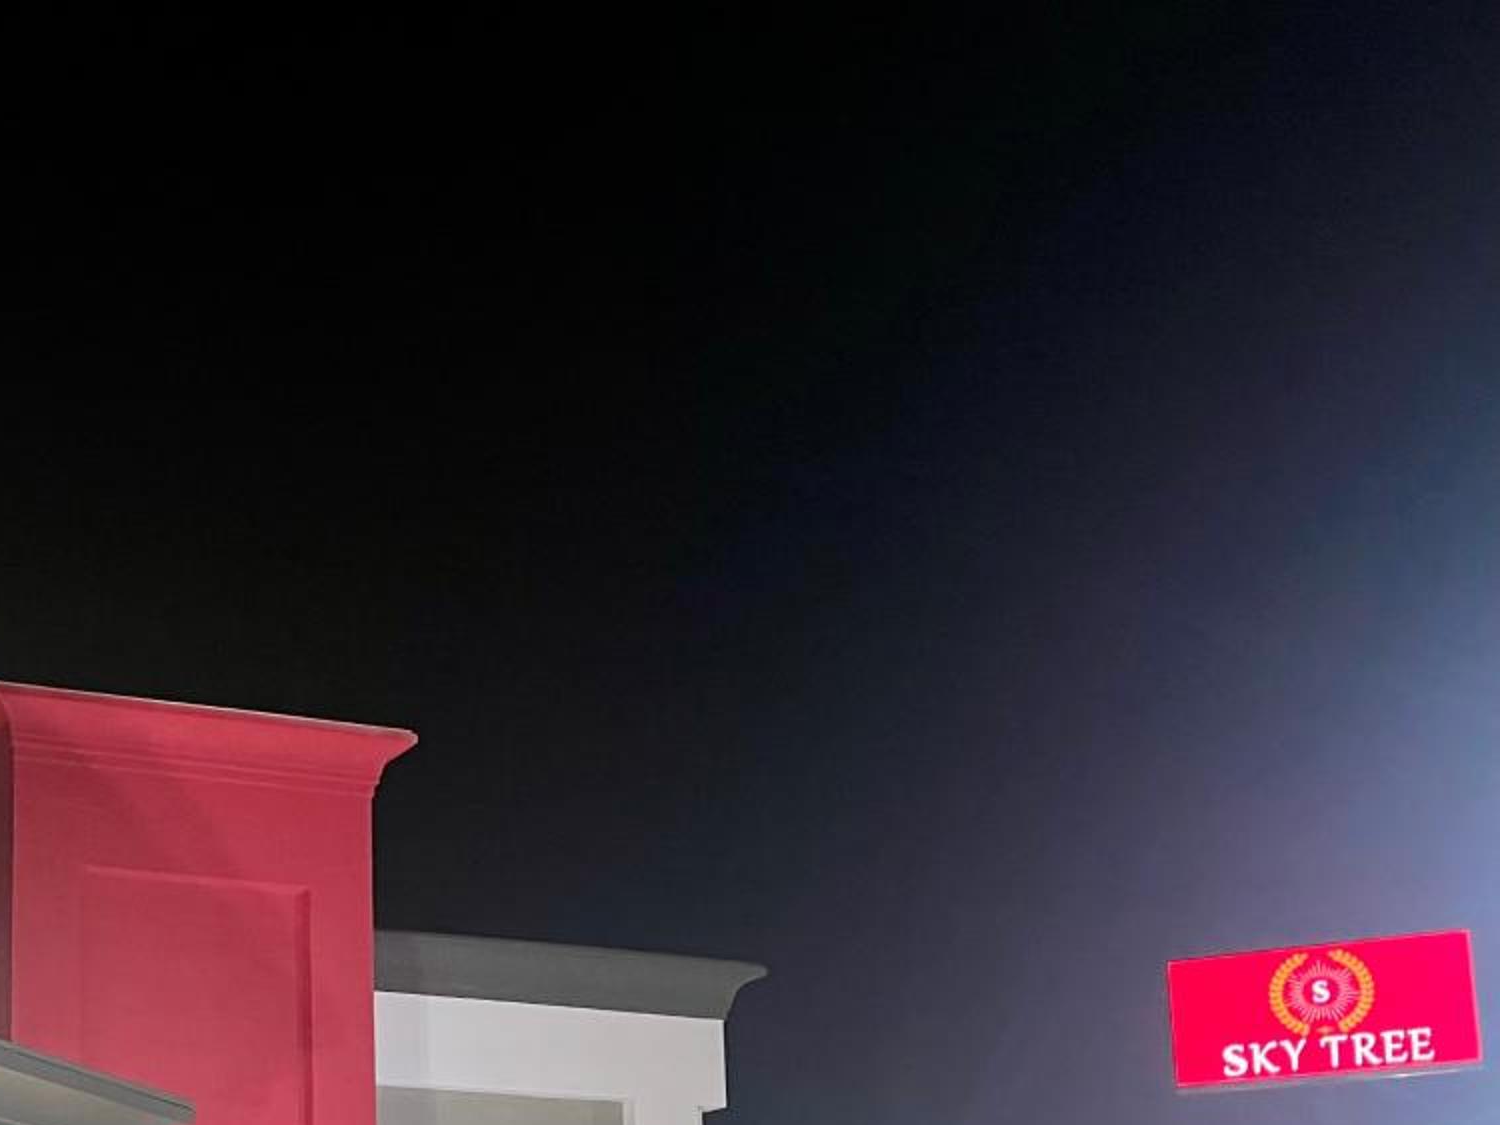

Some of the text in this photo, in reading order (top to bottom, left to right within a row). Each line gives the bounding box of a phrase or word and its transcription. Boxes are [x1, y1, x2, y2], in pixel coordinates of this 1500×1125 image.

[1311, 980, 1330, 1003] S
[1222, 1027, 1435, 1077] SKY TREE
